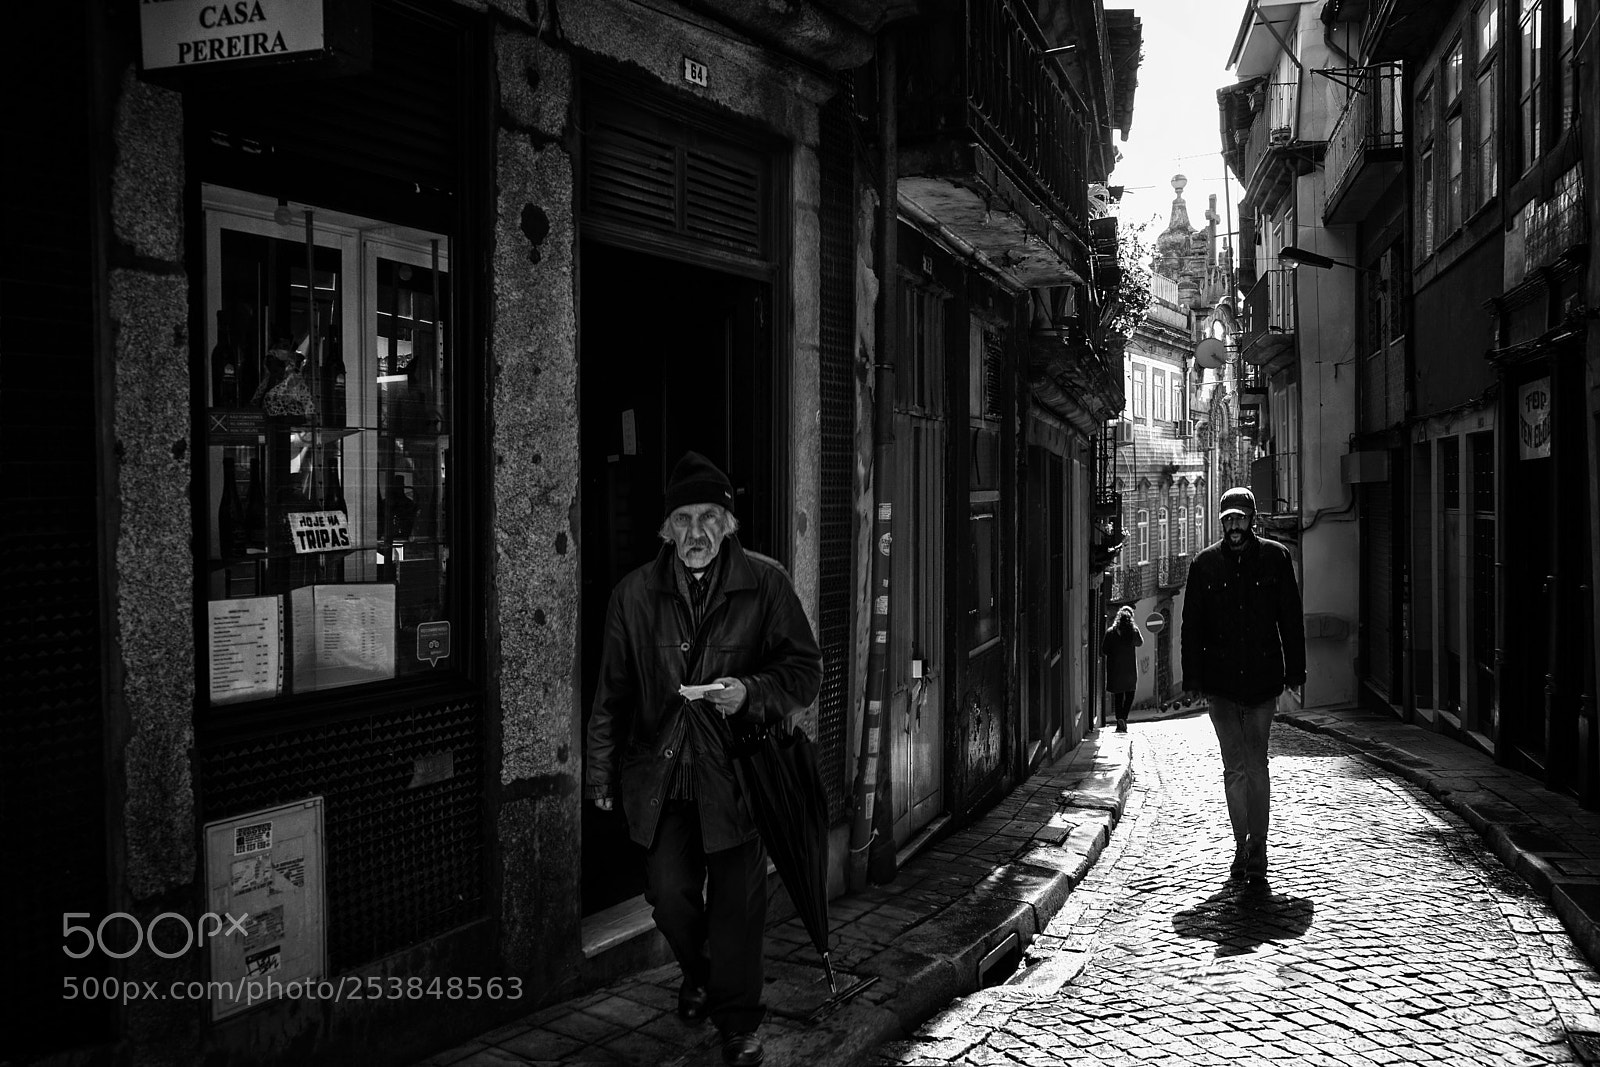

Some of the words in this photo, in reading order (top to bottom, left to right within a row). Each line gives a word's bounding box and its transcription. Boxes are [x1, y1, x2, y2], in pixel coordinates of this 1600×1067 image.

[199, 0, 266, 29] CASA
[177, 30, 288, 64] PEREIRA
[690, 63, 703, 82] 64
[1525, 390, 1547, 413] TOP
[299, 516, 325, 528] HOJE
[296, 528, 350, 550] TRIPAS
